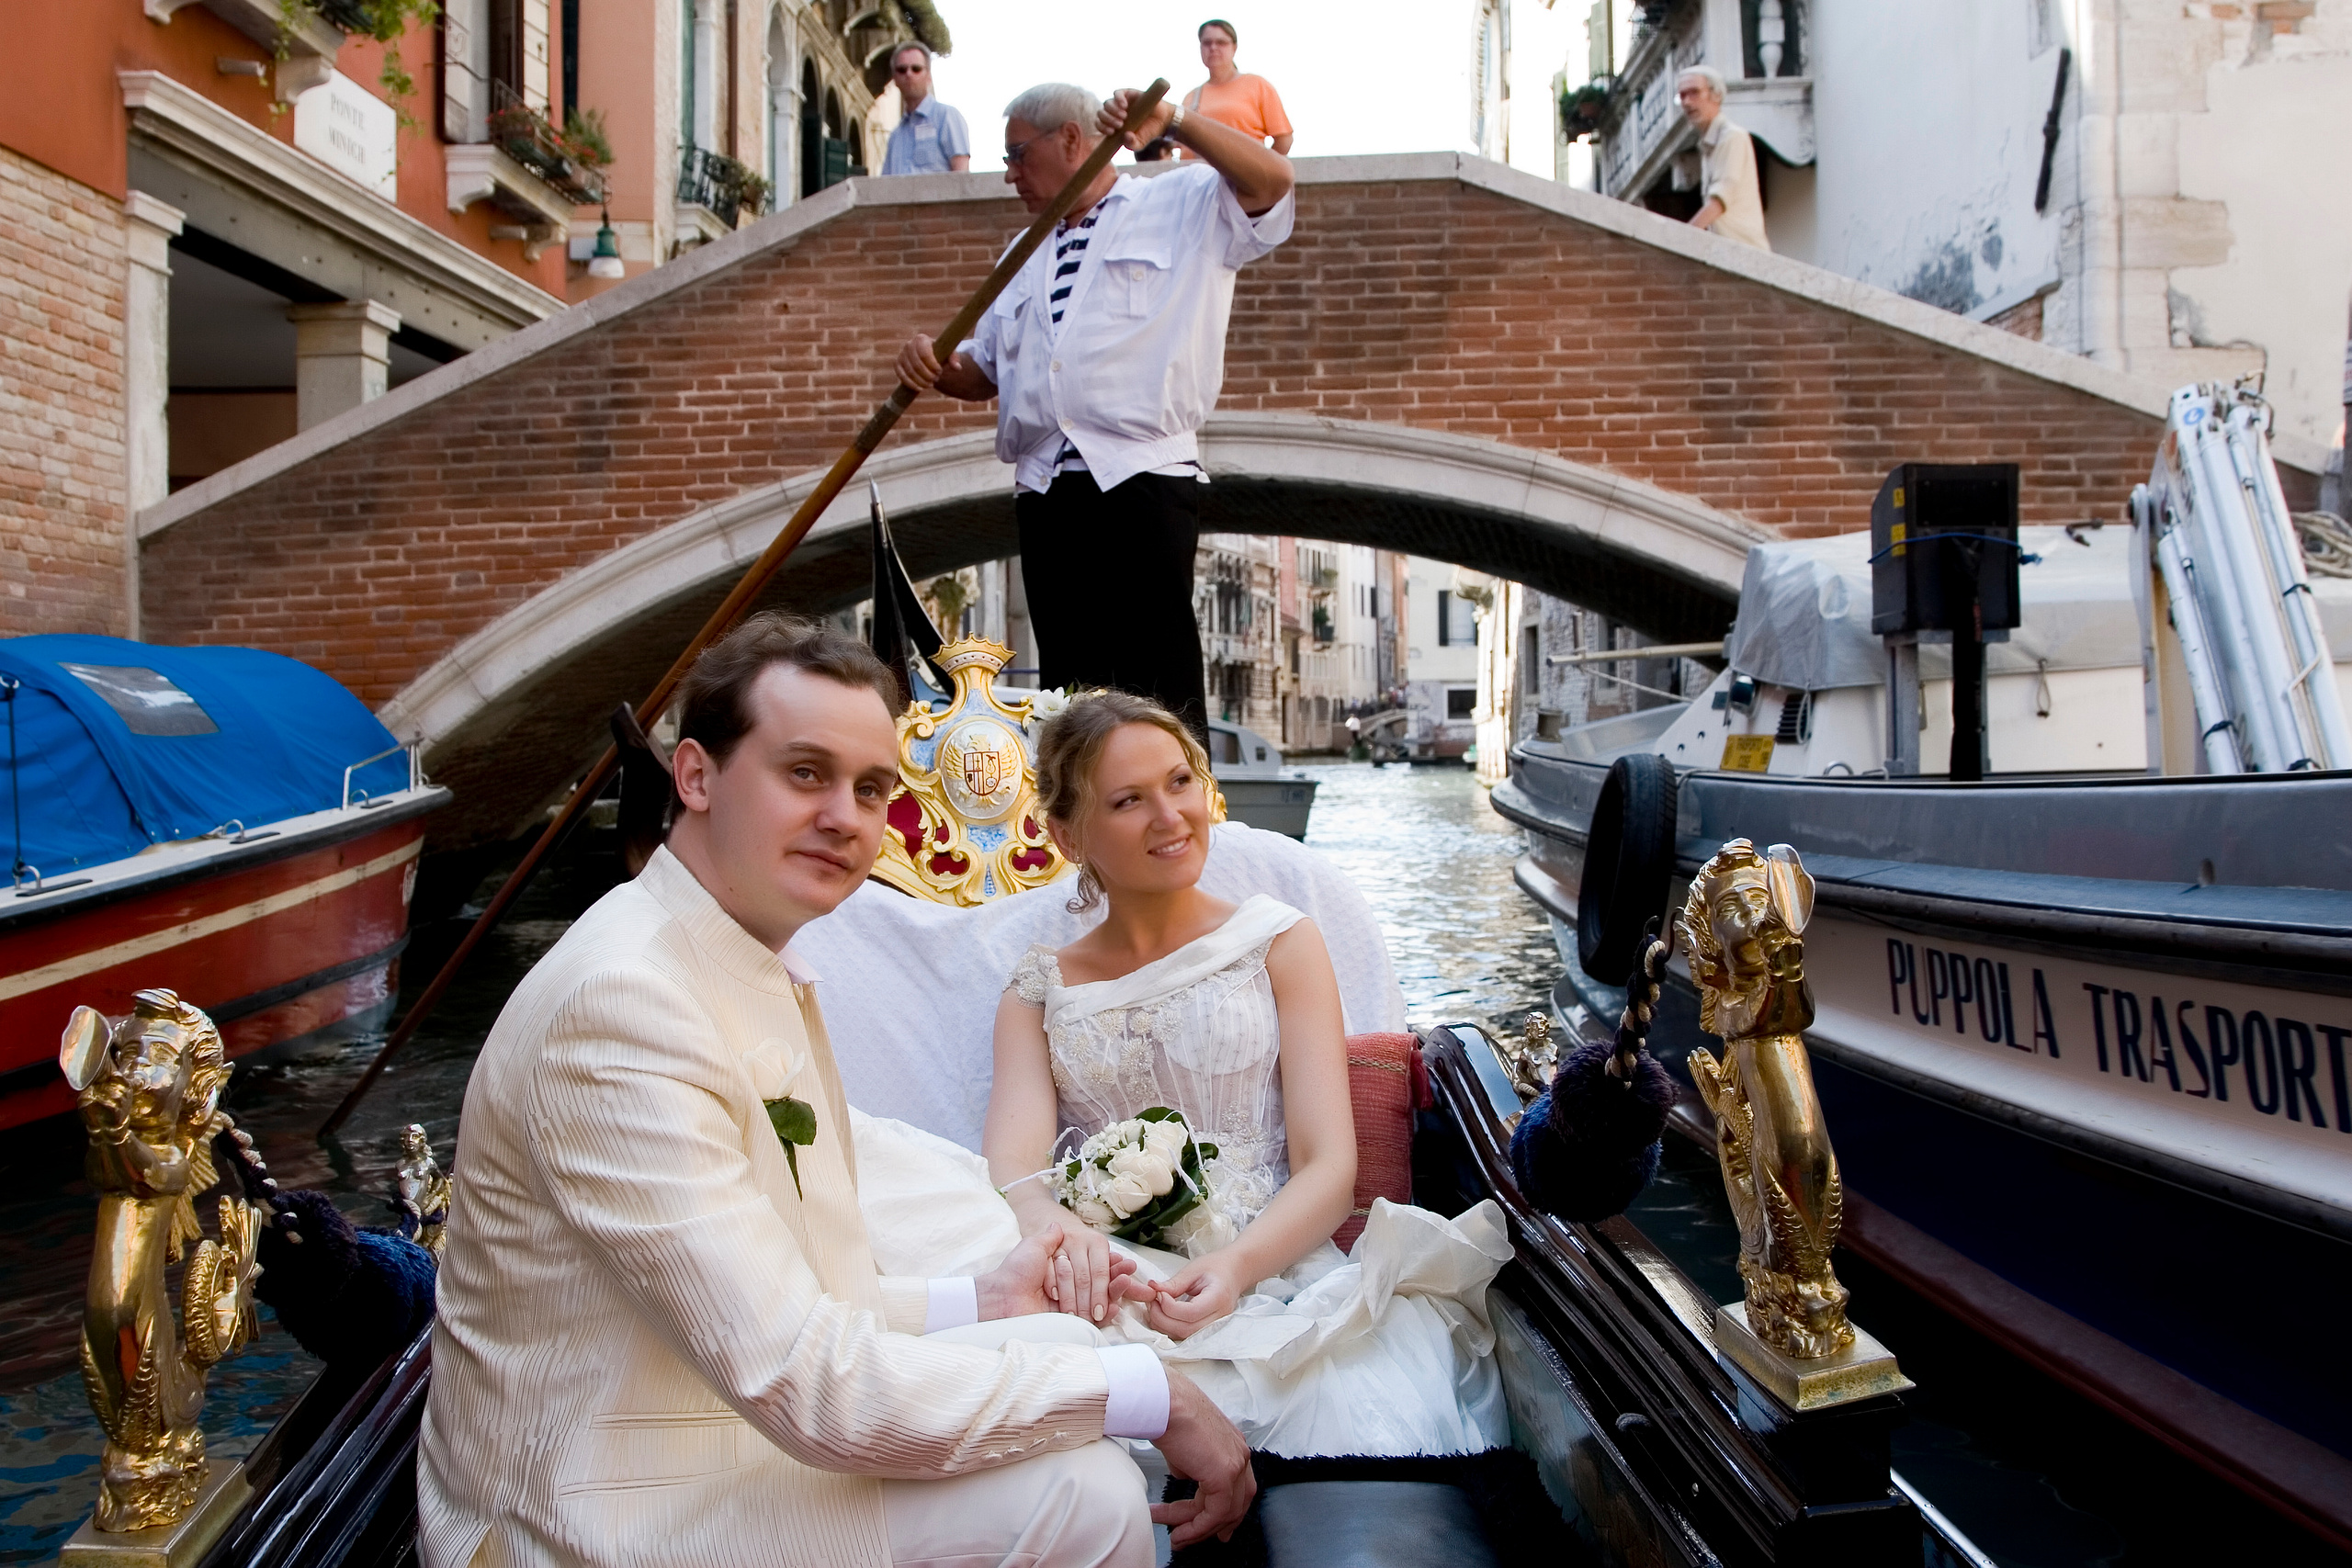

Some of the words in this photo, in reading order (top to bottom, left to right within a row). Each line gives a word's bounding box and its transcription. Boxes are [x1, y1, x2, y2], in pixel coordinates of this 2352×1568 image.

[331, 92, 365, 130] PONTE
[1886, 938, 2061, 1059] PUPPOLA
[2082, 982, 2352, 1134] TRASPORT
